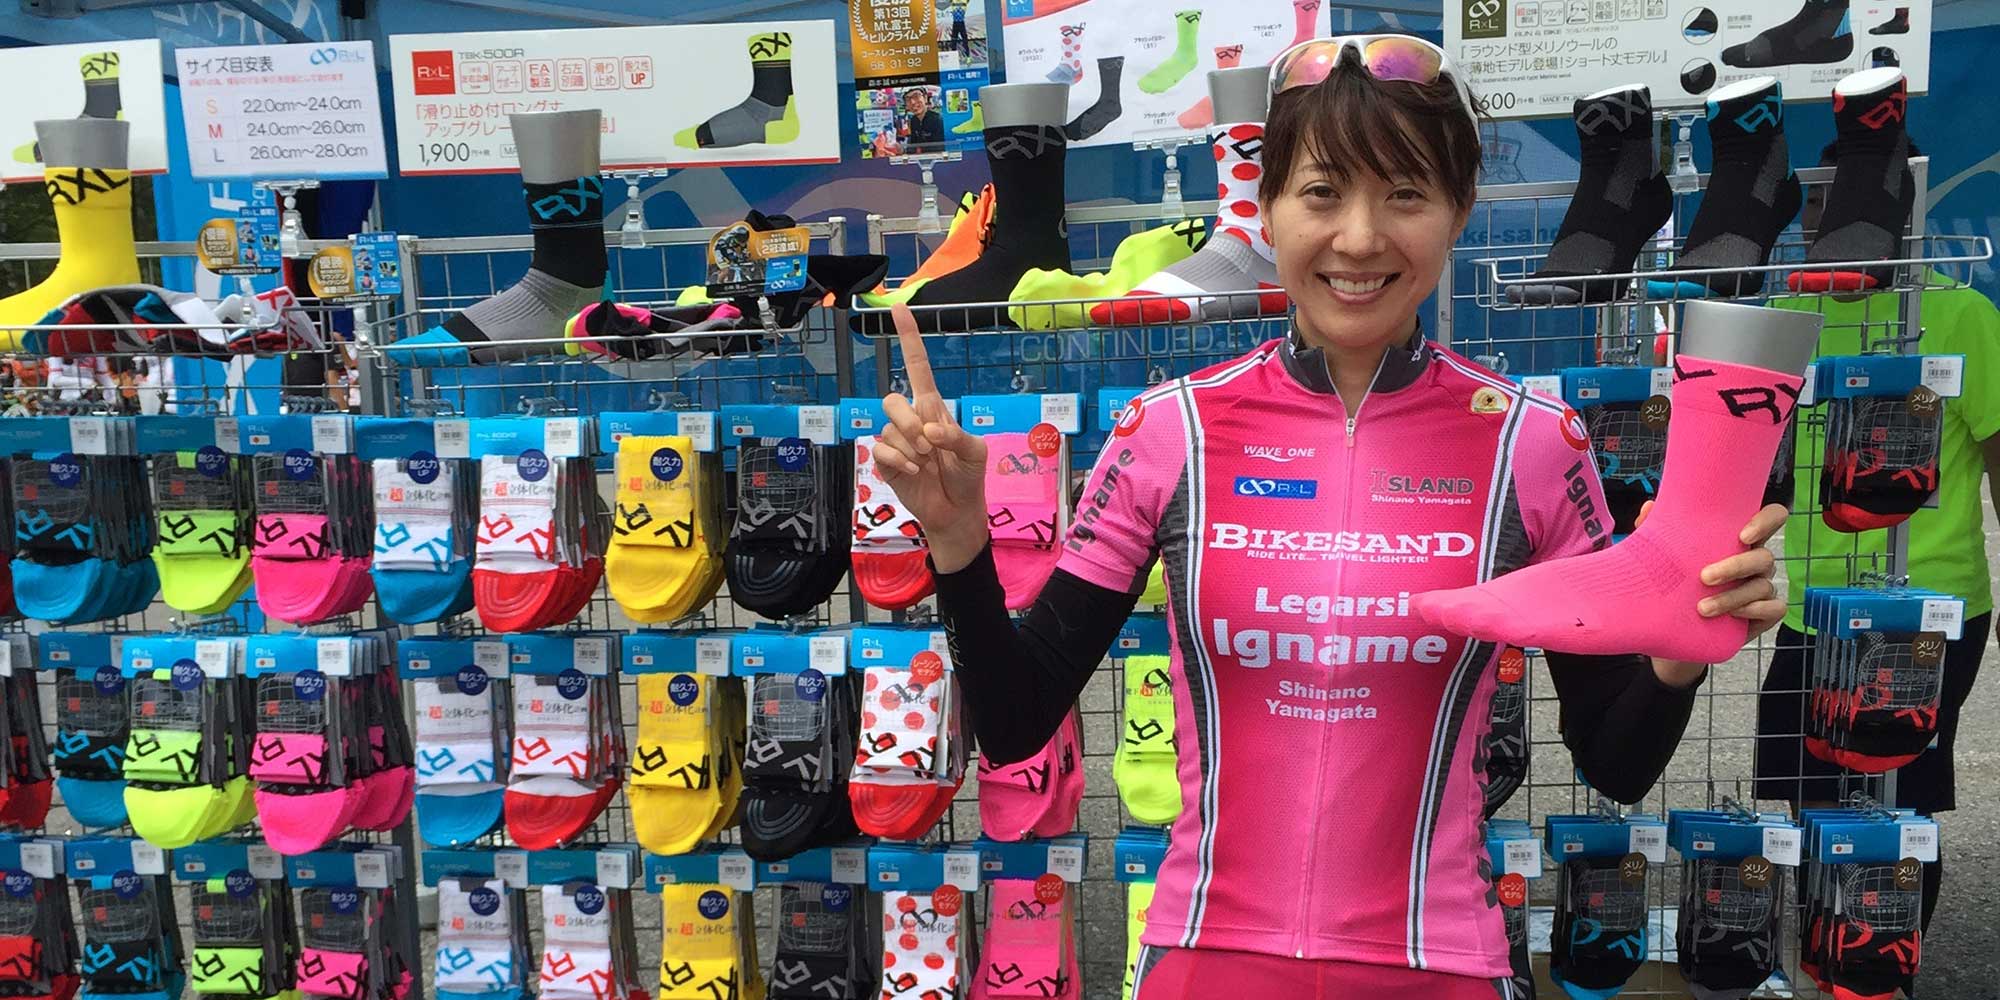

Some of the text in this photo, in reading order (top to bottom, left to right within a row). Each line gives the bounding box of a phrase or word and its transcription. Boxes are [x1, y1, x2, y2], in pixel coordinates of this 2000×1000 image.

[186, 56, 274, 74] サイズ目安表
[631, 72, 646, 85] UP
[207, 99, 218, 114] S
[208, 124, 223, 138] M
[214, 148, 224, 162] L
[418, 142, 470, 166] 1,900
[1029, 432, 1059, 443] レーシング
[778, 446, 806, 457] 耐久力
[1034, 442, 1056, 450] モデル
[1244, 444, 1315, 457] WAVE ONE
[519, 457, 547, 468] 耐久力
[653, 456, 681, 466] 耐久力
[786, 455, 798, 464] UP
[527, 467, 538, 475] UP
[1370, 468, 1474, 494] ISLAND
[1067, 448, 1135, 552] Igname
[1371, 494, 1472, 506] Shinano Yamagata
[1209, 522, 1475, 558] BIKESAND
[1247, 550, 1278, 560] RIDE
[1369, 554, 1429, 564] LIGHTER!
[1254, 587, 1410, 623] Legarsi
[1213, 618, 1448, 669] Igname
[670, 683, 697, 693] 耐久力
[799, 678, 825, 688] 耐久力
[806, 686, 817, 694] UP
[1279, 681, 1371, 700] Shinano
[1265, 699, 1378, 723] Yamagata
